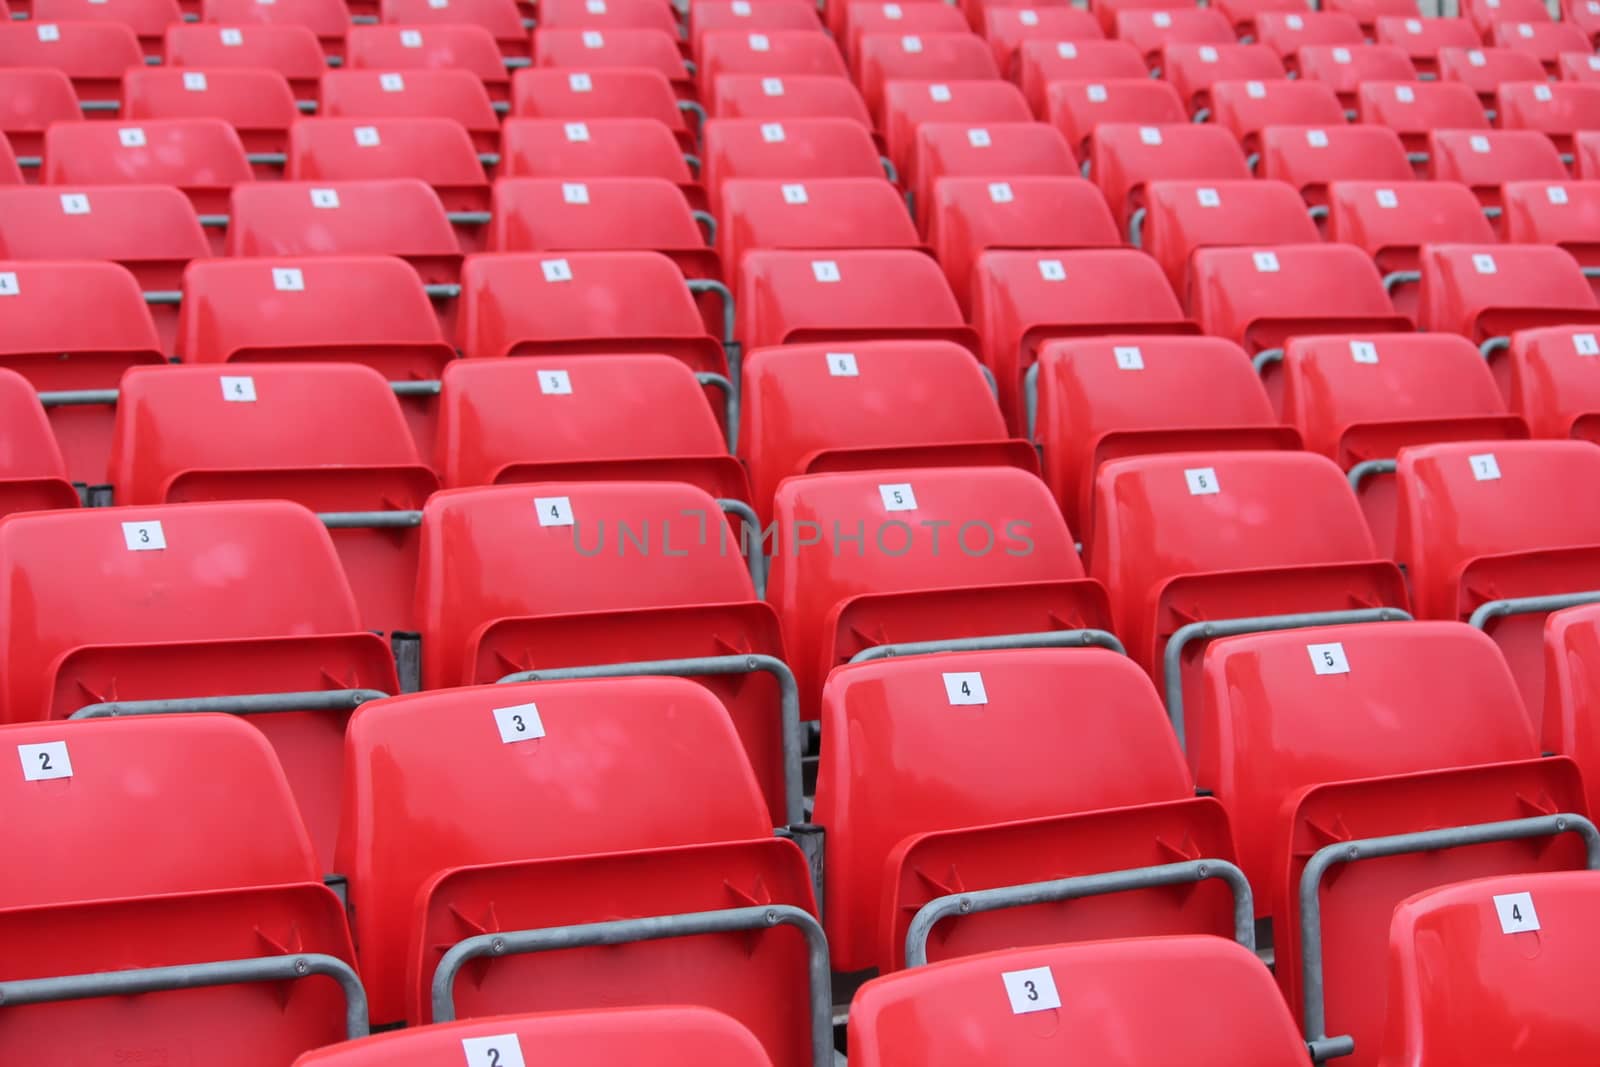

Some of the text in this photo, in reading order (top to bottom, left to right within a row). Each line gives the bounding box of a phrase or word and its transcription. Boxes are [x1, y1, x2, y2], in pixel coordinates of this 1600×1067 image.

[838, 359, 847, 372] 6
[235, 383, 243, 395] 4
[550, 376, 560, 389] 5
[1480, 461, 1489, 473] 7
[1198, 475, 1208, 489] 6
[893, 491, 904, 505] 5
[550, 505, 560, 519] 4
[138, 528, 150, 543] 3
[1323, 651, 1334, 667] 5
[961, 680, 971, 697] 4
[512, 714, 526, 732] 3
[38, 752, 53, 770] 2
[1512, 903, 1523, 922] 4
[1024, 980, 1039, 1001] 3
[487, 1047, 503, 1067] 2
